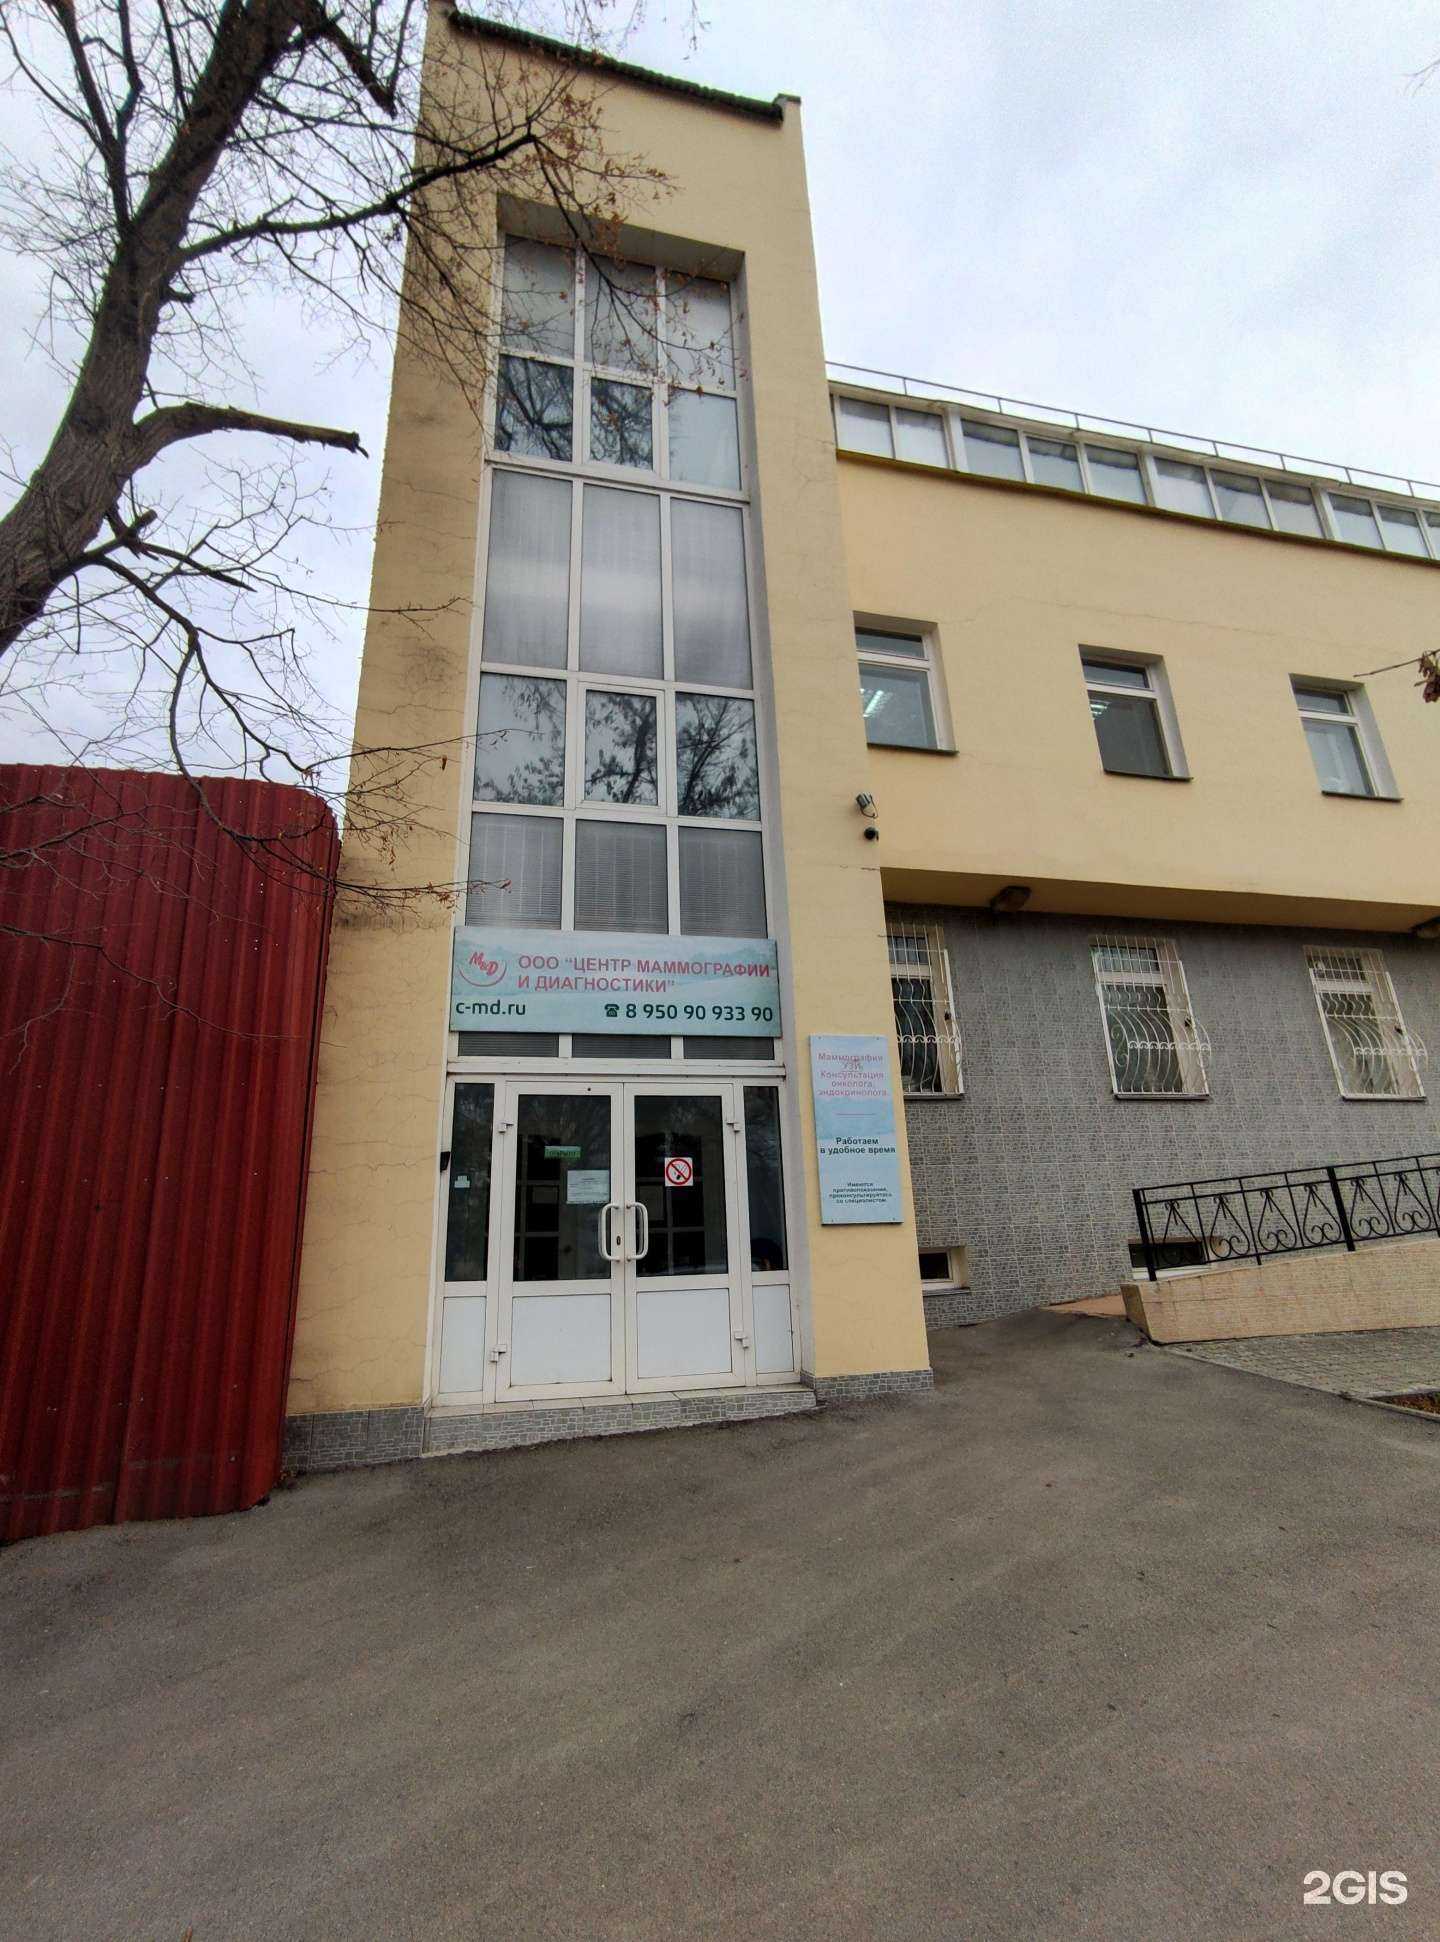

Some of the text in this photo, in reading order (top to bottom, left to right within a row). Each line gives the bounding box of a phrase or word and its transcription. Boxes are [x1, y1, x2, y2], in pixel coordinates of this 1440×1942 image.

[518, 955, 770, 977] ООО "ЦЕНТР МАММОГРАФИИ
[517, 975, 675, 993] И ДИАГНОСТИКИ"
[455, 1000, 526, 1016] c-md.ru
[625, 1003, 773, 1022] 8 950 90 933 90
[835, 1136, 879, 1145] Работаем
[828, 1146, 866, 1155] удобное
[868, 1147, 896, 1155] время
